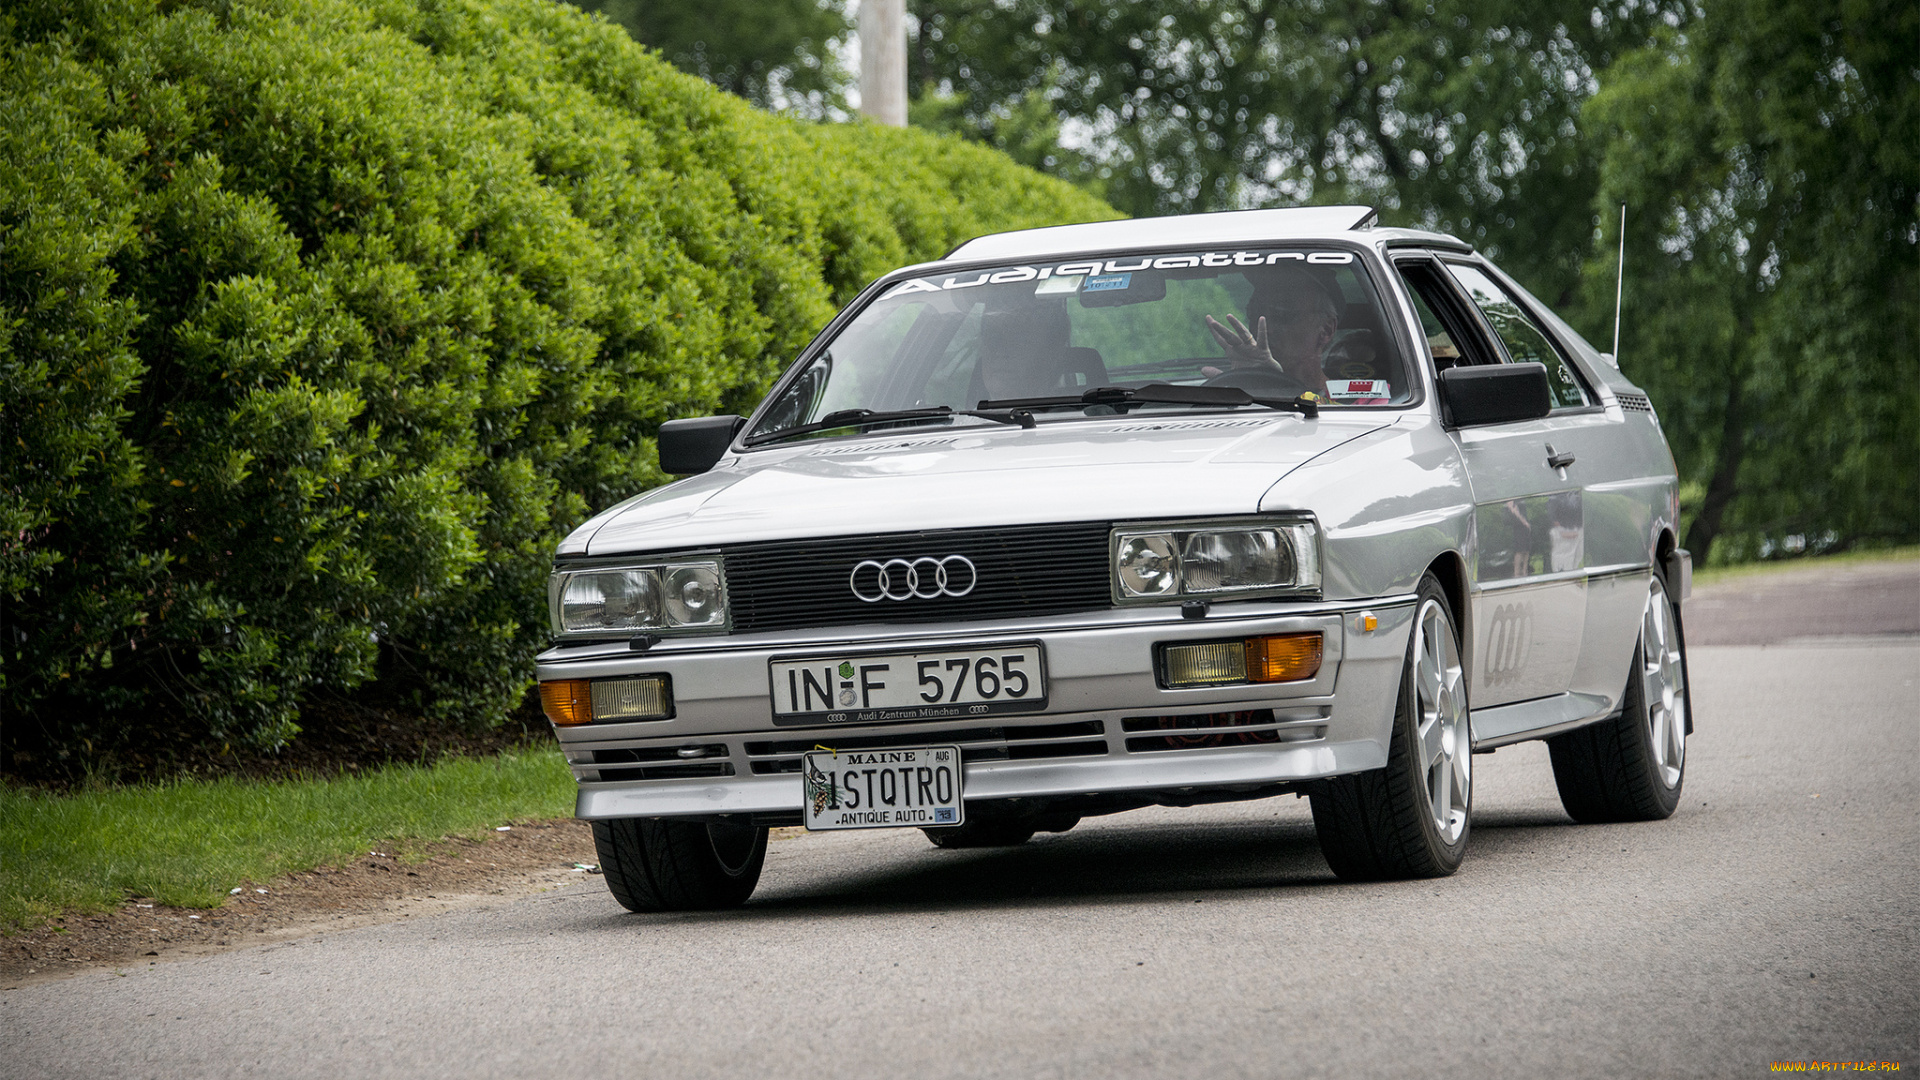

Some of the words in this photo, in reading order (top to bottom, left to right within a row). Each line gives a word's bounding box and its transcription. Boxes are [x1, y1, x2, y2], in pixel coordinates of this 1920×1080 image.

[917, 655, 1028, 703] 5765
[857, 712, 878, 721] Audi
[879, 709, 917, 720] Zentrum
[919, 706, 960, 717] München
[847, 752, 916, 765] MAINE
[935, 750, 950, 761] AUG
[826, 765, 952, 811] 1STQTRO
[939, 812, 952, 820] 13
